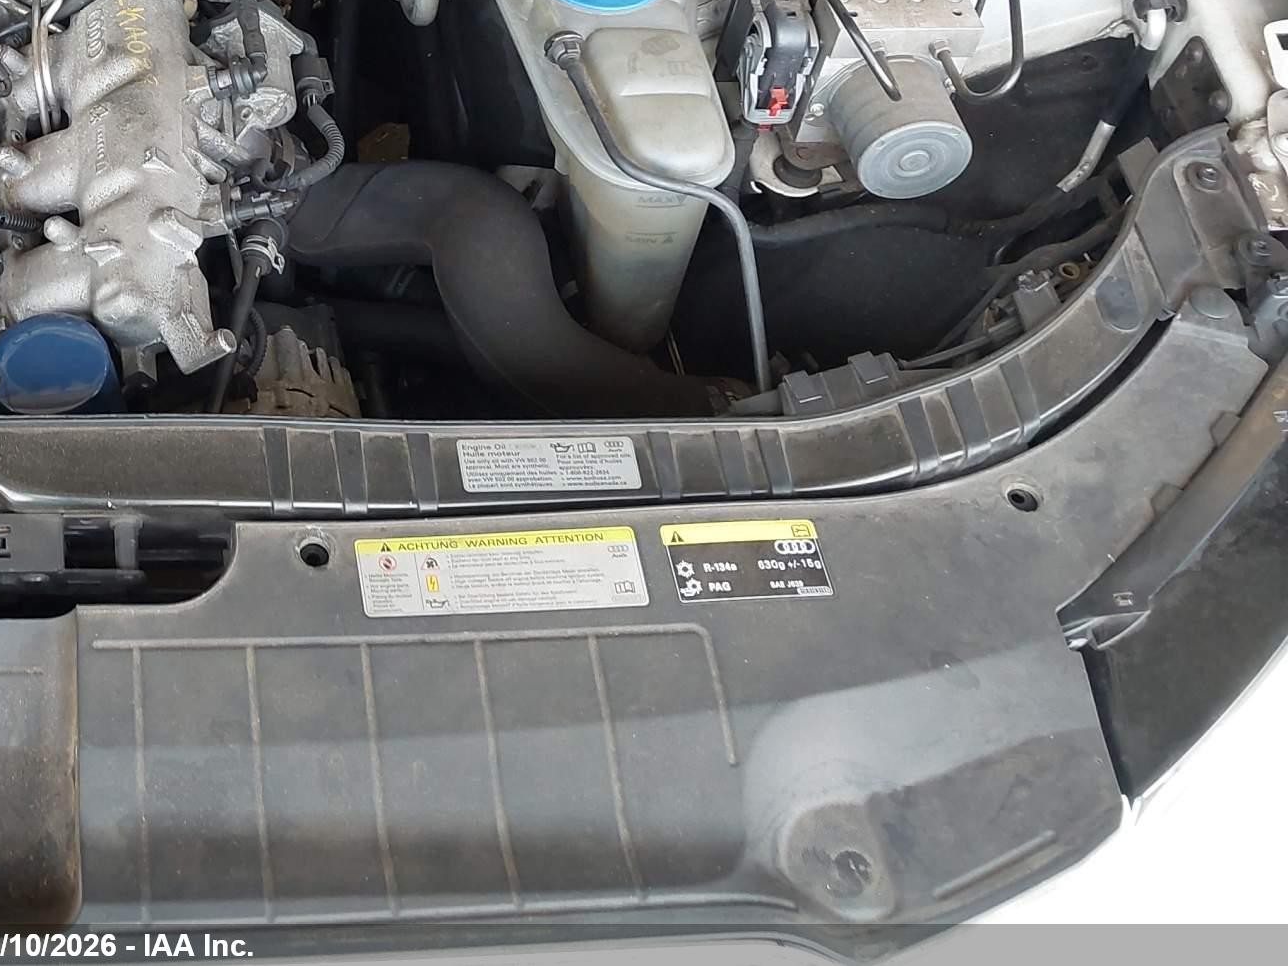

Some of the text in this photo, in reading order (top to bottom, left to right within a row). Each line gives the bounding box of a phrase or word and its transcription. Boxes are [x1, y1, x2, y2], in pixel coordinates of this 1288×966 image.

[398, 532, 604, 551] ACHTUNG WARNING ATTENTION
[702, 561, 738, 573] R-134a
[708, 581, 732, 592] PAG
